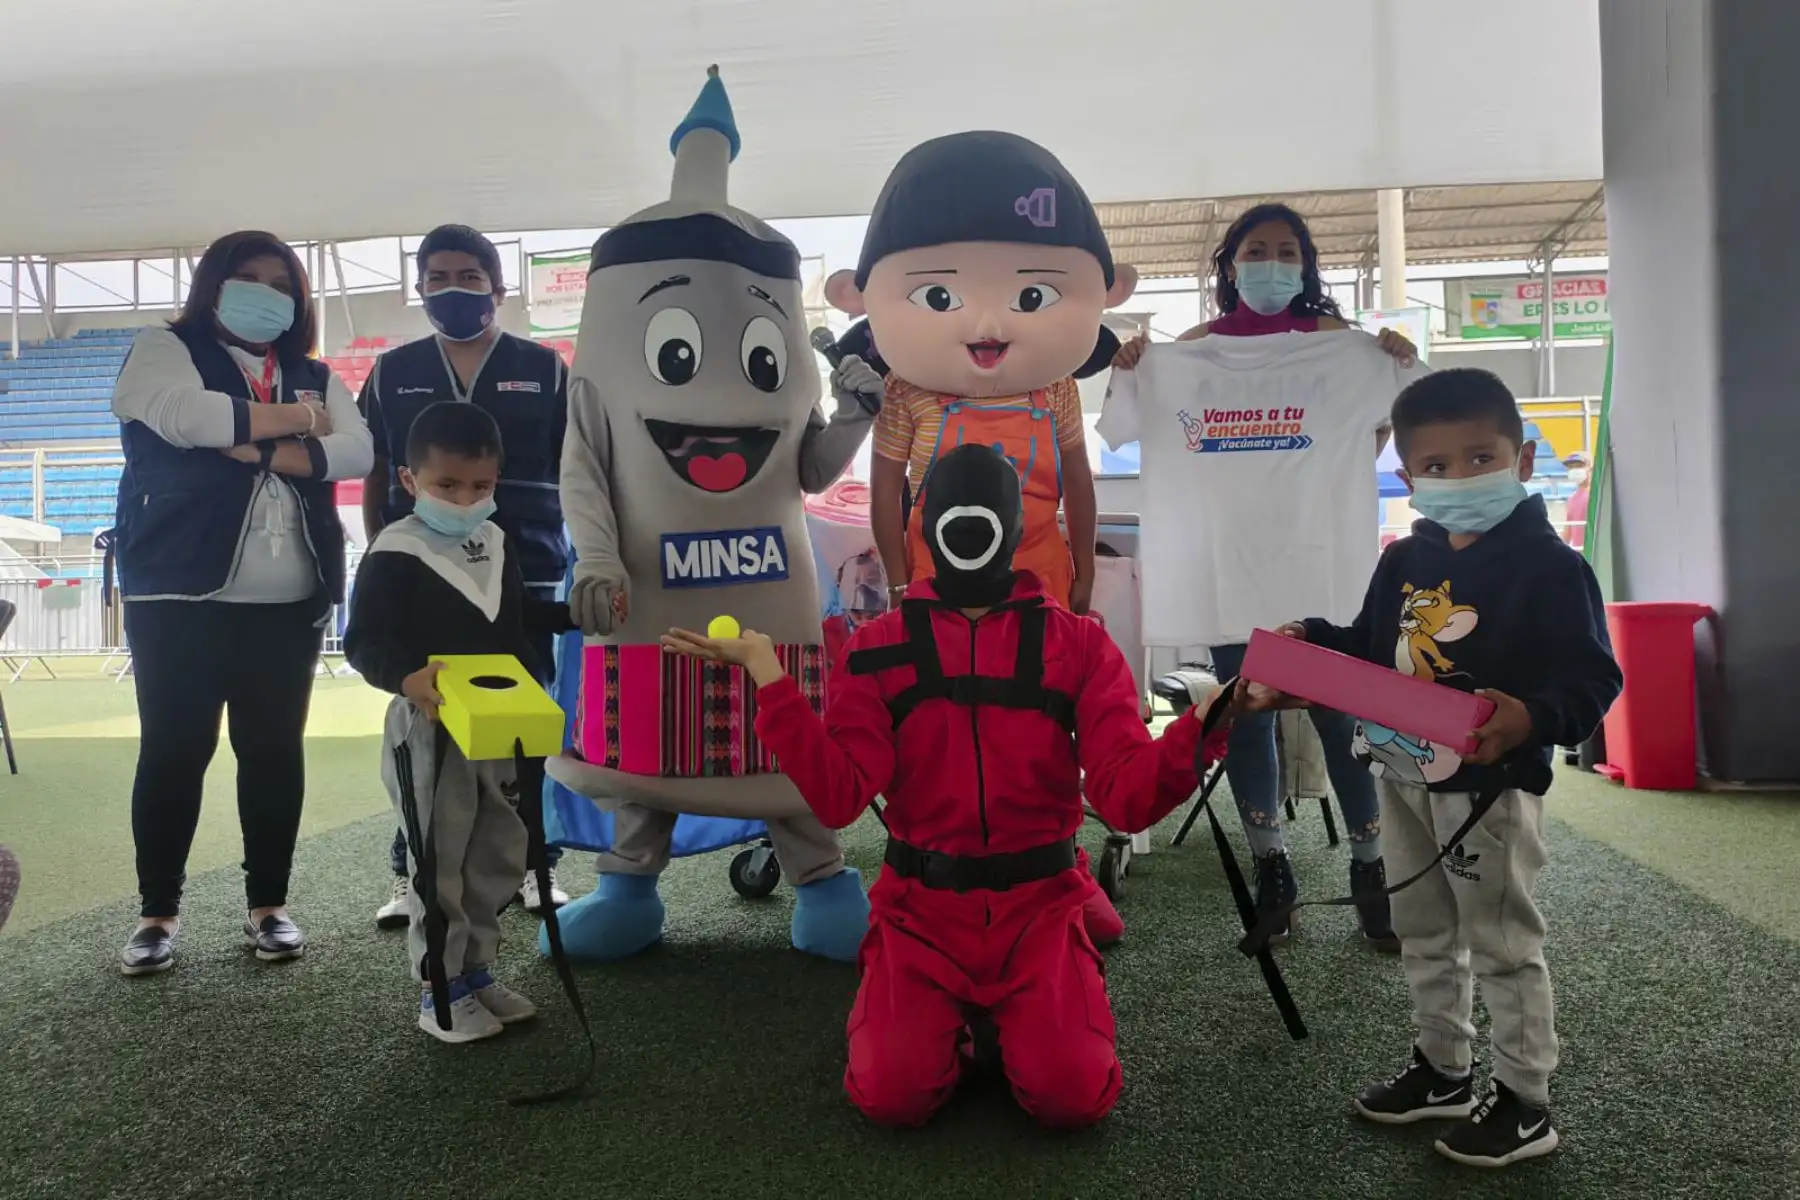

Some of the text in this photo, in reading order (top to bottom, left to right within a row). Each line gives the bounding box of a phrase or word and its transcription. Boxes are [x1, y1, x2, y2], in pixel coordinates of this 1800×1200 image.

[1574, 300, 1599, 315] LO
[1203, 405, 1304, 423] Vamos a tu
[1207, 421, 1301, 438] encuentro
[1218, 438, 1290, 451] ¡Vacúnate ya!
[664, 535, 785, 579] MINSA
